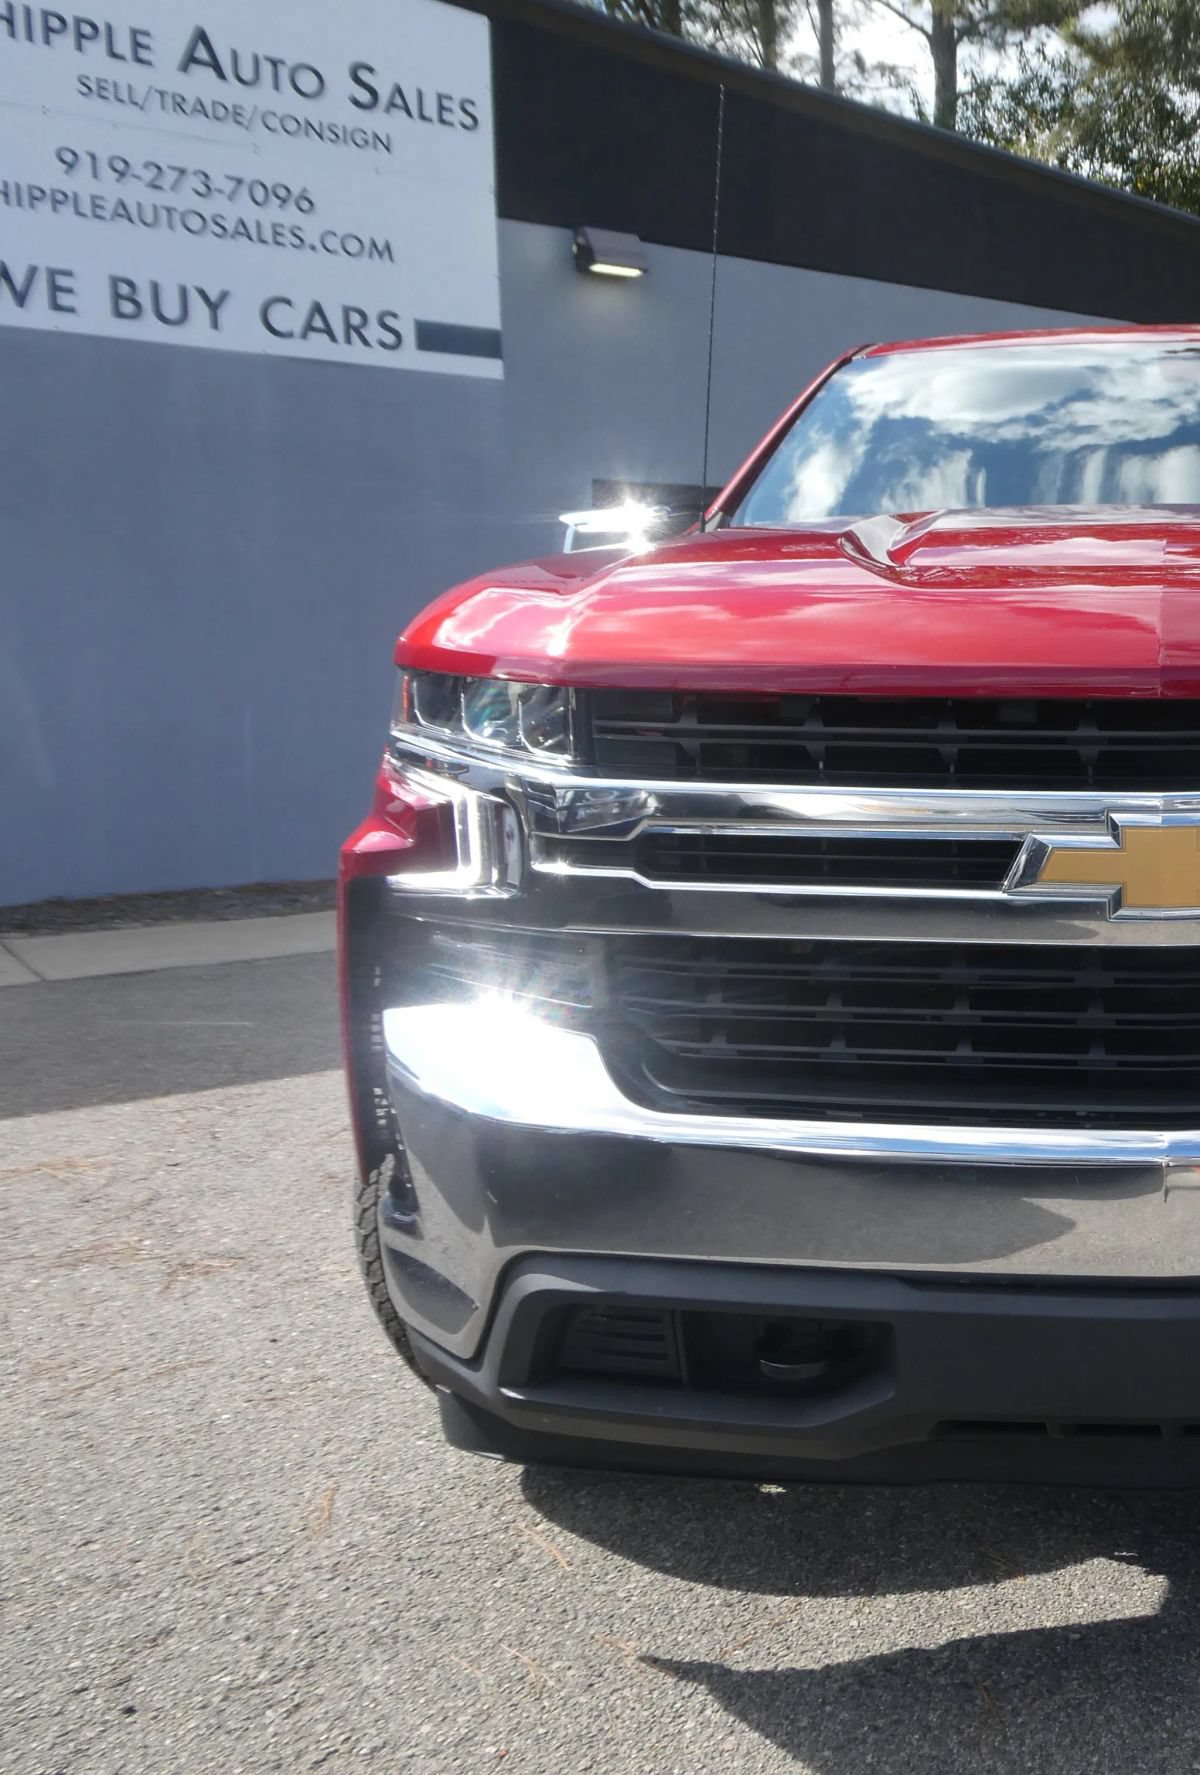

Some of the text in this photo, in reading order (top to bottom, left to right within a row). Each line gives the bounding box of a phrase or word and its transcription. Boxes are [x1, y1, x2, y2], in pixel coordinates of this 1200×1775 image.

[76, 73, 393, 155] SELL/TRADE/CONSIGN
[54, 146, 316, 216] 919-273-7096
[108, 274, 231, 332] BUY
[258, 295, 404, 351] CARS
